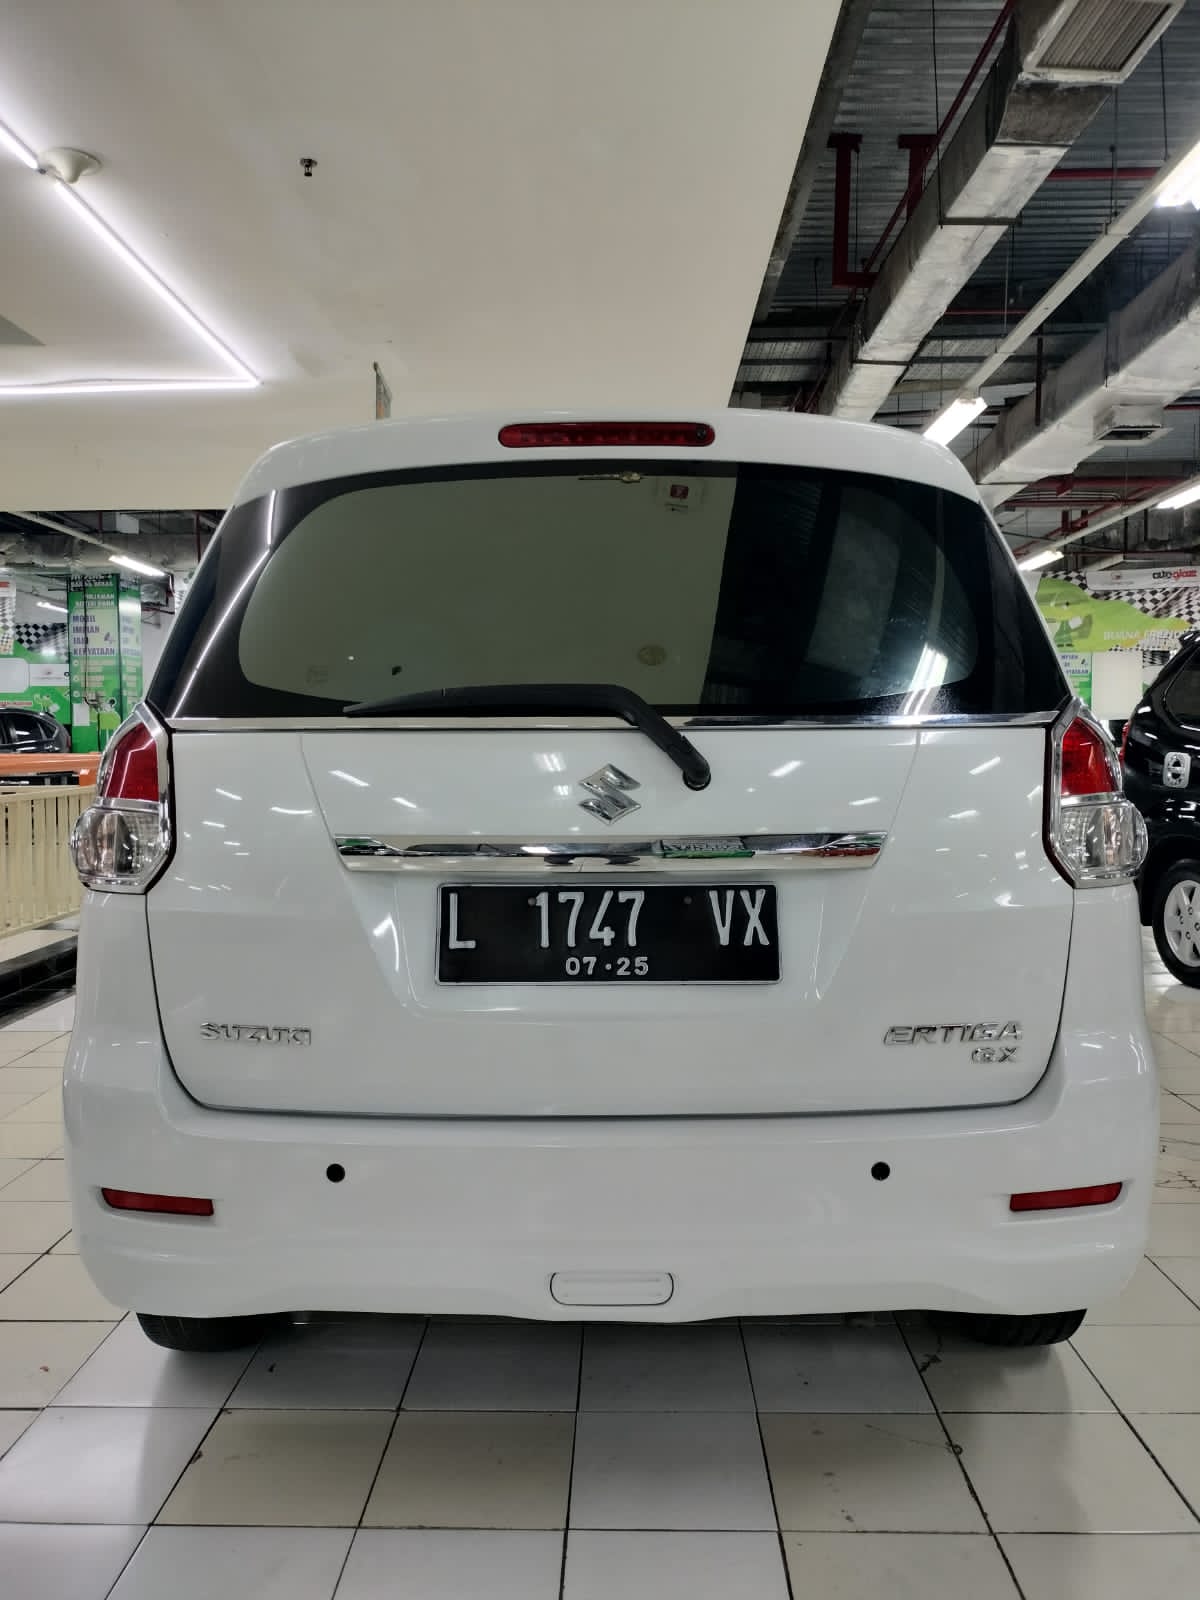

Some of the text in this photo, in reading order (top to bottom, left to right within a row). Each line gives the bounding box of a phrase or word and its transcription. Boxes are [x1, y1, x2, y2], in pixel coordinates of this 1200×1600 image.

[448, 888, 770, 949] L 1747 VX
[200, 1022, 312, 1046] SUZUKI
[883, 1020, 1023, 1046] ERTIGA
[970, 1046, 1018, 1064] GX
